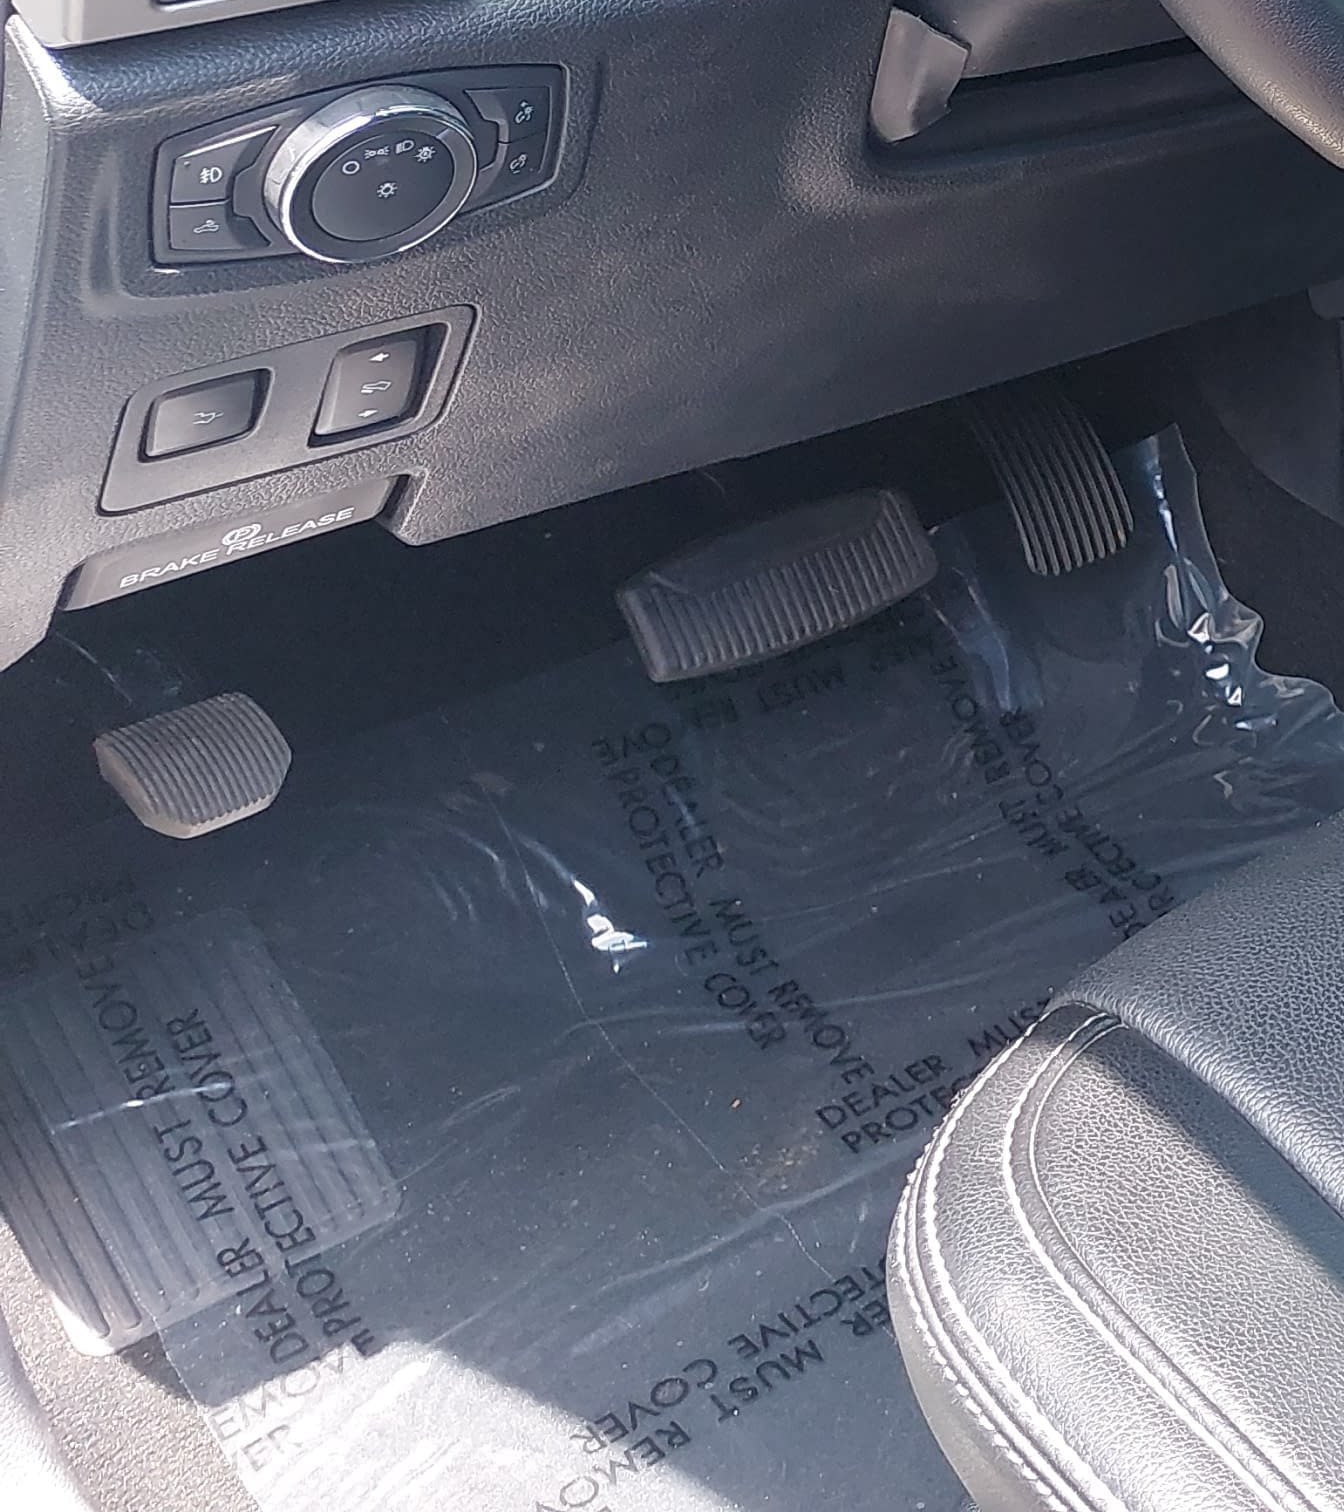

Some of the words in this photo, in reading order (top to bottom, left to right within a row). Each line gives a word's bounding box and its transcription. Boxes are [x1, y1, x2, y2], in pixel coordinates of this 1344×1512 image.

[119, 549, 220, 589] BRAKE
[226, 507, 355, 555] RELEASE
[607, 768, 719, 967] PROTECTIVE
[709, 897, 779, 976] MUST
[75, 955, 176, 1103] REMOVE
[165, 1007, 249, 1128] COVER
[815, 1054, 950, 1130] DEALER
[153, 1118, 235, 1222] MUST
[227, 1134, 362, 1338] PROTECTIVE
[215, 1236, 309, 1365] DEALER
[569, 1358, 719, 1454] COVER
[709, 1339, 825, 1423] MUST
